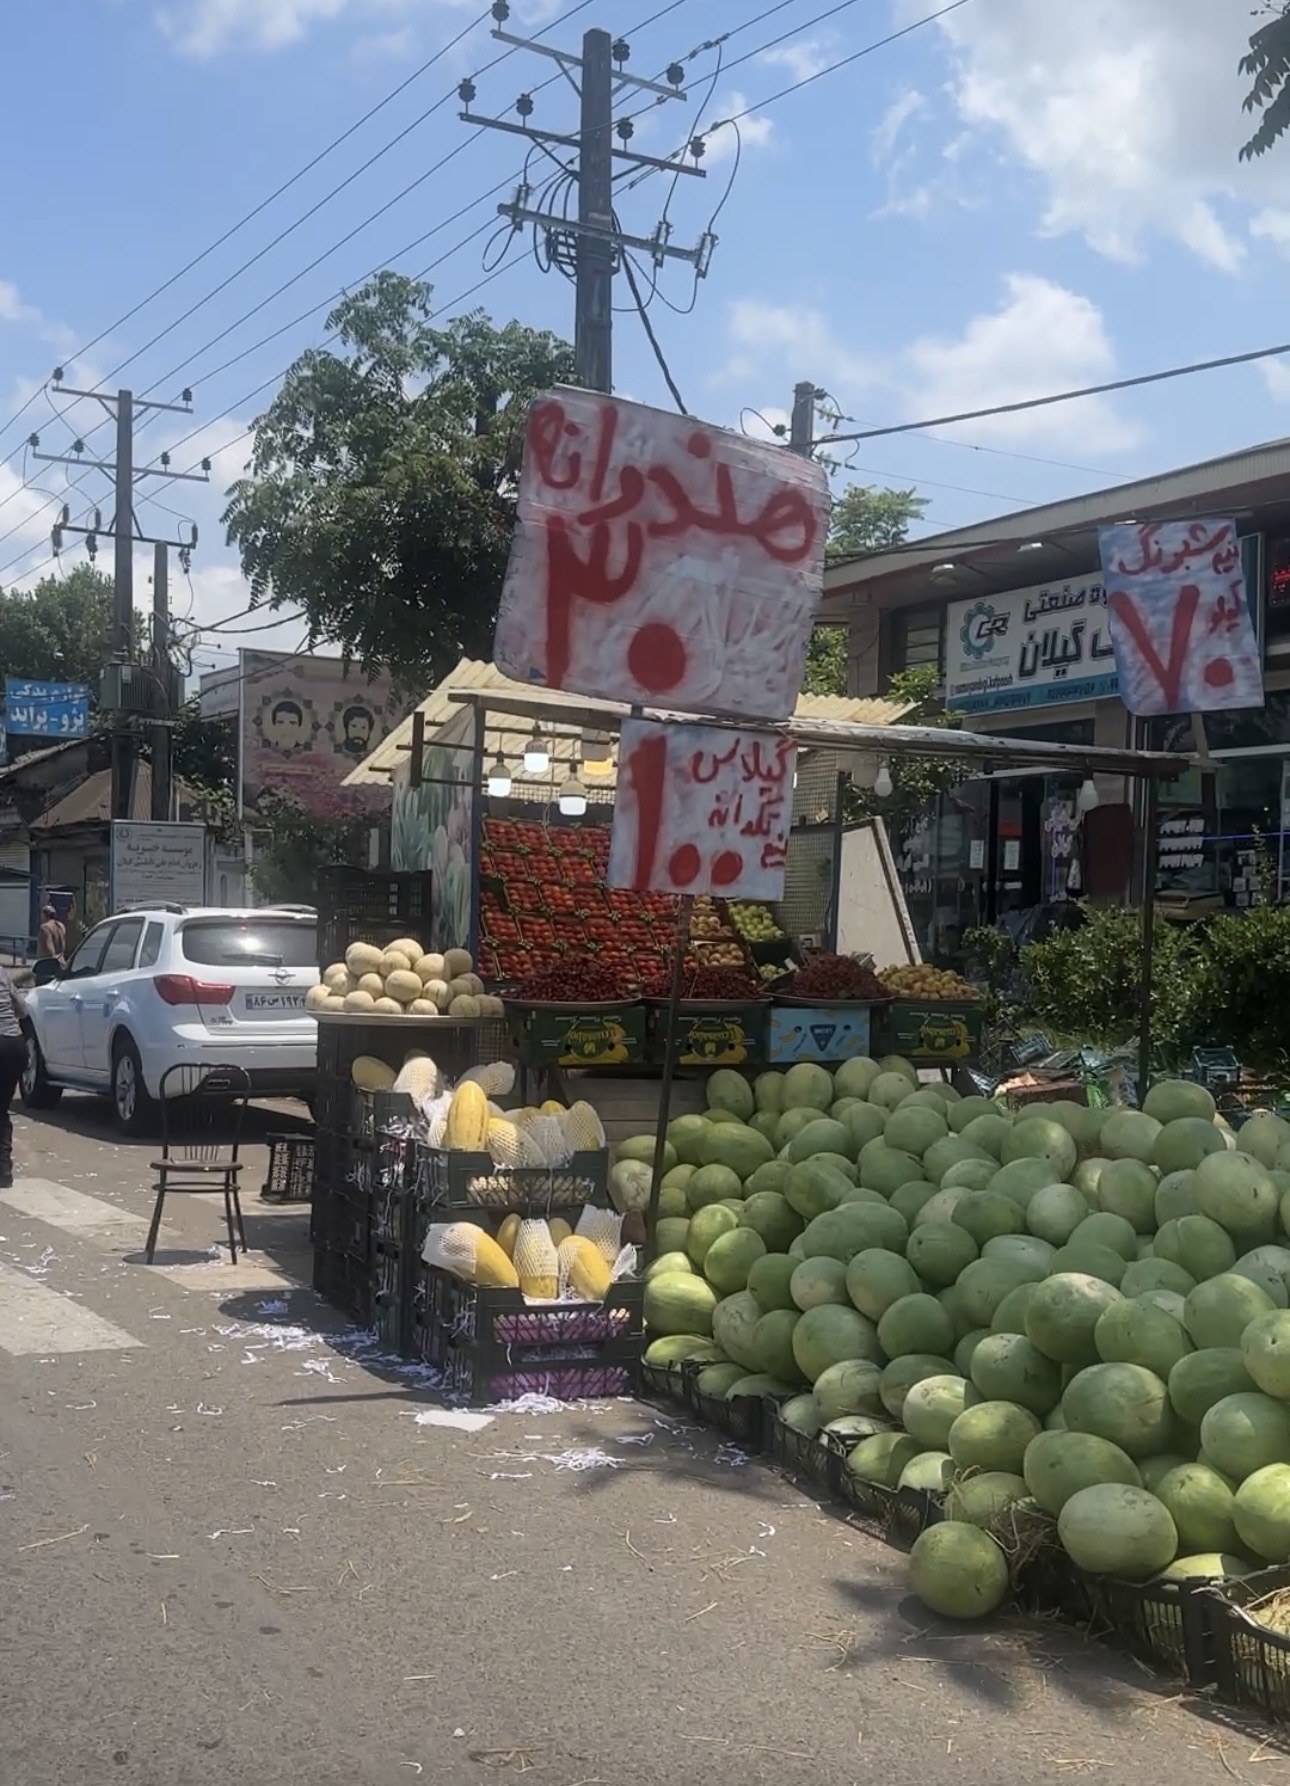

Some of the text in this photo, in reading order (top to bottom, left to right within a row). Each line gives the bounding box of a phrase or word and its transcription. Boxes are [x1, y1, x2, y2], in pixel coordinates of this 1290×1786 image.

[527, 399, 818, 563] هندوانه
[1018, 618, 1087, 679] گیلان
[1108, 584, 1235, 711] ۷۰
[10, 702, 48, 732] پراید
[60, 706, 85, 732] پژو
[691, 736, 798, 783] گیلاس
